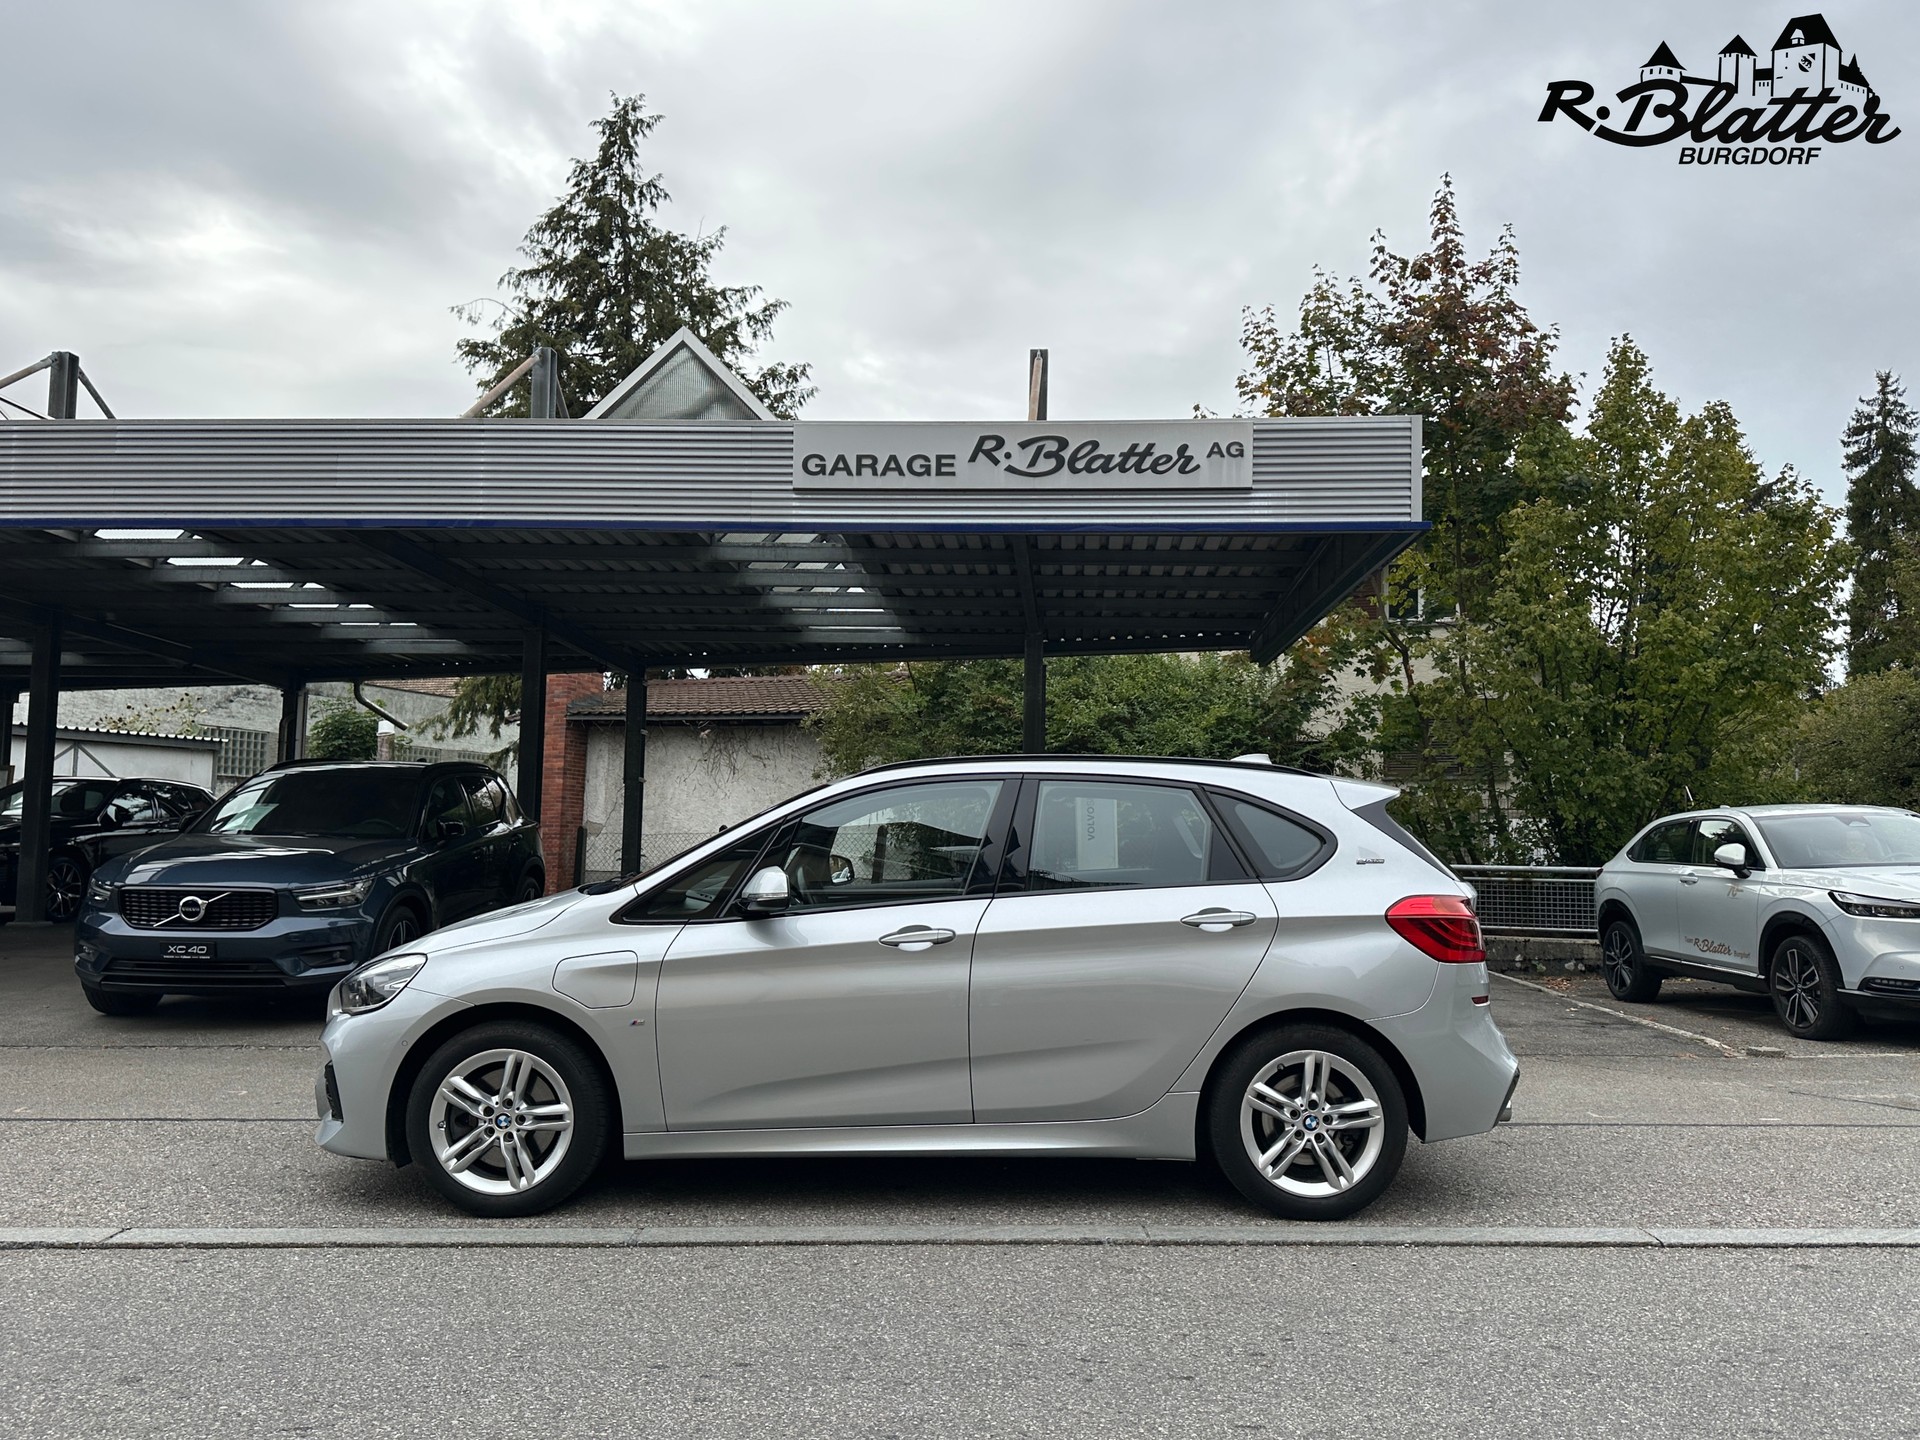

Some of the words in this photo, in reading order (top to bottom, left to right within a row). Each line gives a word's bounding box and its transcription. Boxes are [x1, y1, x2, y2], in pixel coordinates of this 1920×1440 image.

[801, 453, 956, 477] GARAGE
[1206, 441, 1245, 459] AG
[1087, 806, 1095, 840] VOLVO
